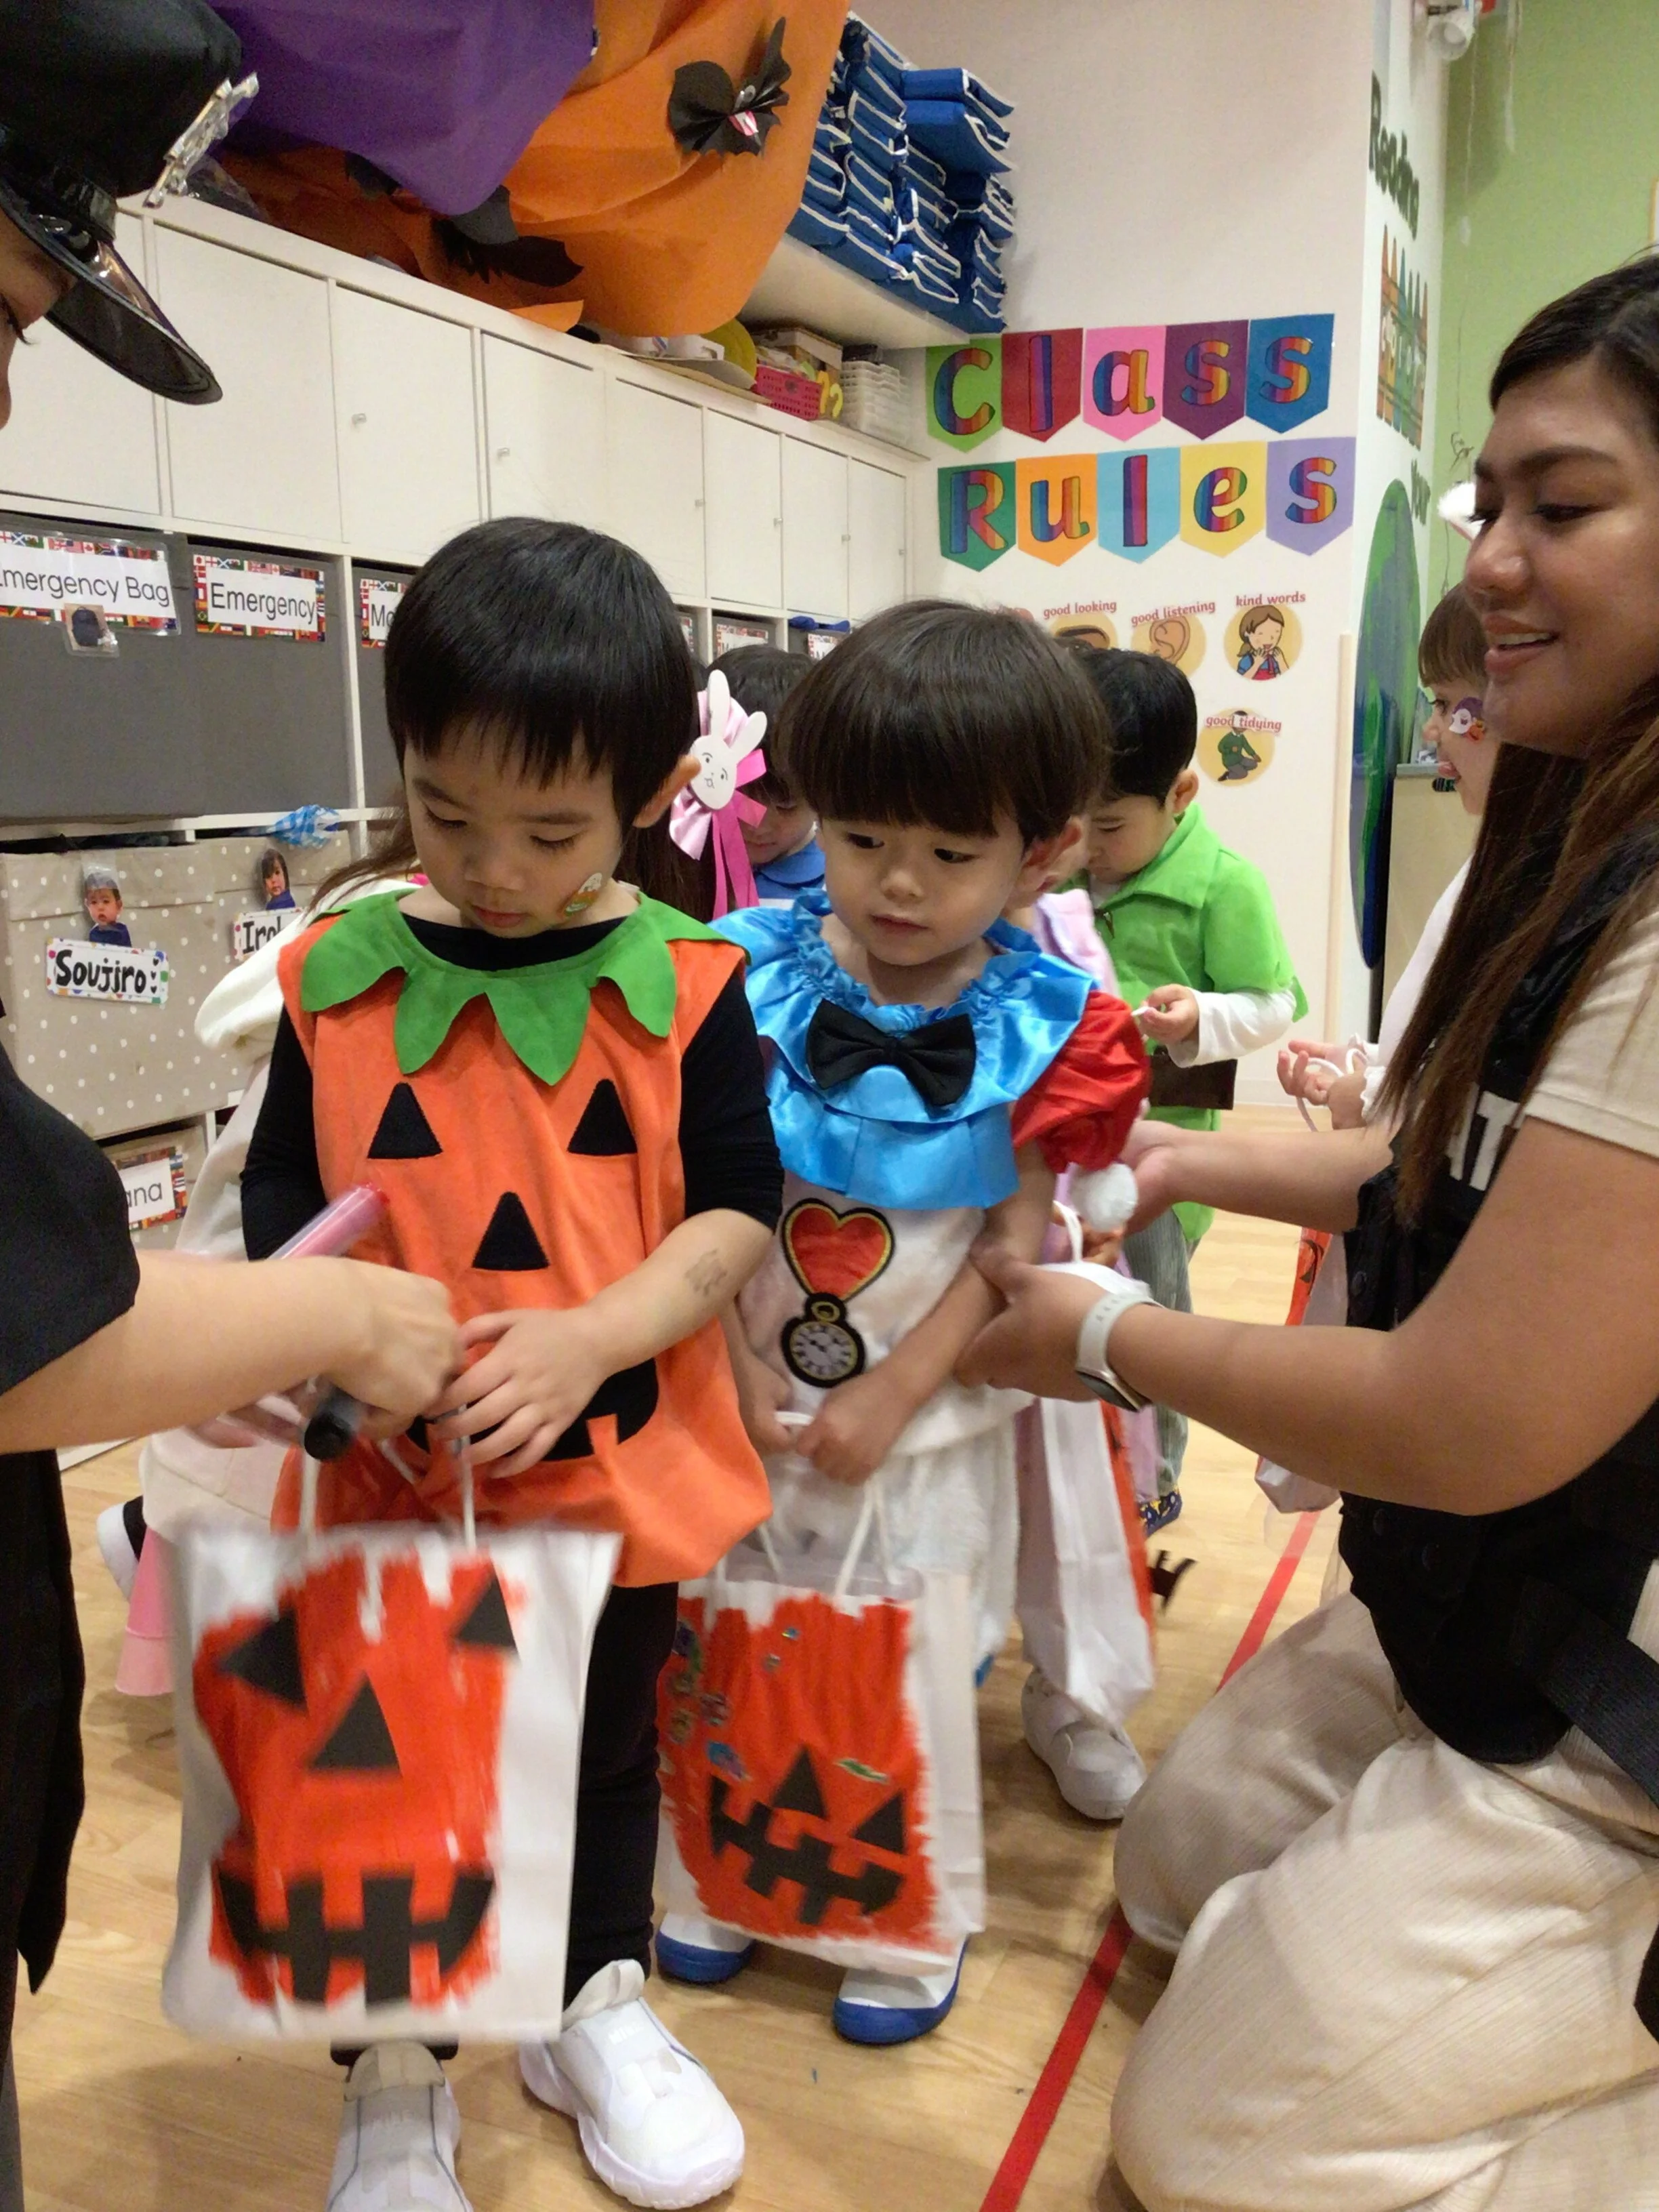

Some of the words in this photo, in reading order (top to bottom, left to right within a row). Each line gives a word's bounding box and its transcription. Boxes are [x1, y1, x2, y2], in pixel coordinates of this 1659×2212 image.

[933, 334, 1314, 435] Class
[949, 454, 1337, 554] Rules
[0, 569, 119, 602] mergency
[125, 576, 169, 607] Bag
[210, 581, 315, 624] Emergency
[1235, 594, 1263, 607] kind
[1267, 590, 1306, 605] words
[1043, 602, 1071, 620] good
[1074, 600, 1118, 614] looking
[1130, 609, 1160, 628] good
[1163, 600, 1216, 619] listening
[1206, 714, 1235, 728] good
[1239, 715, 1282, 733] tidying
[55, 949, 147, 994] Soujiro
